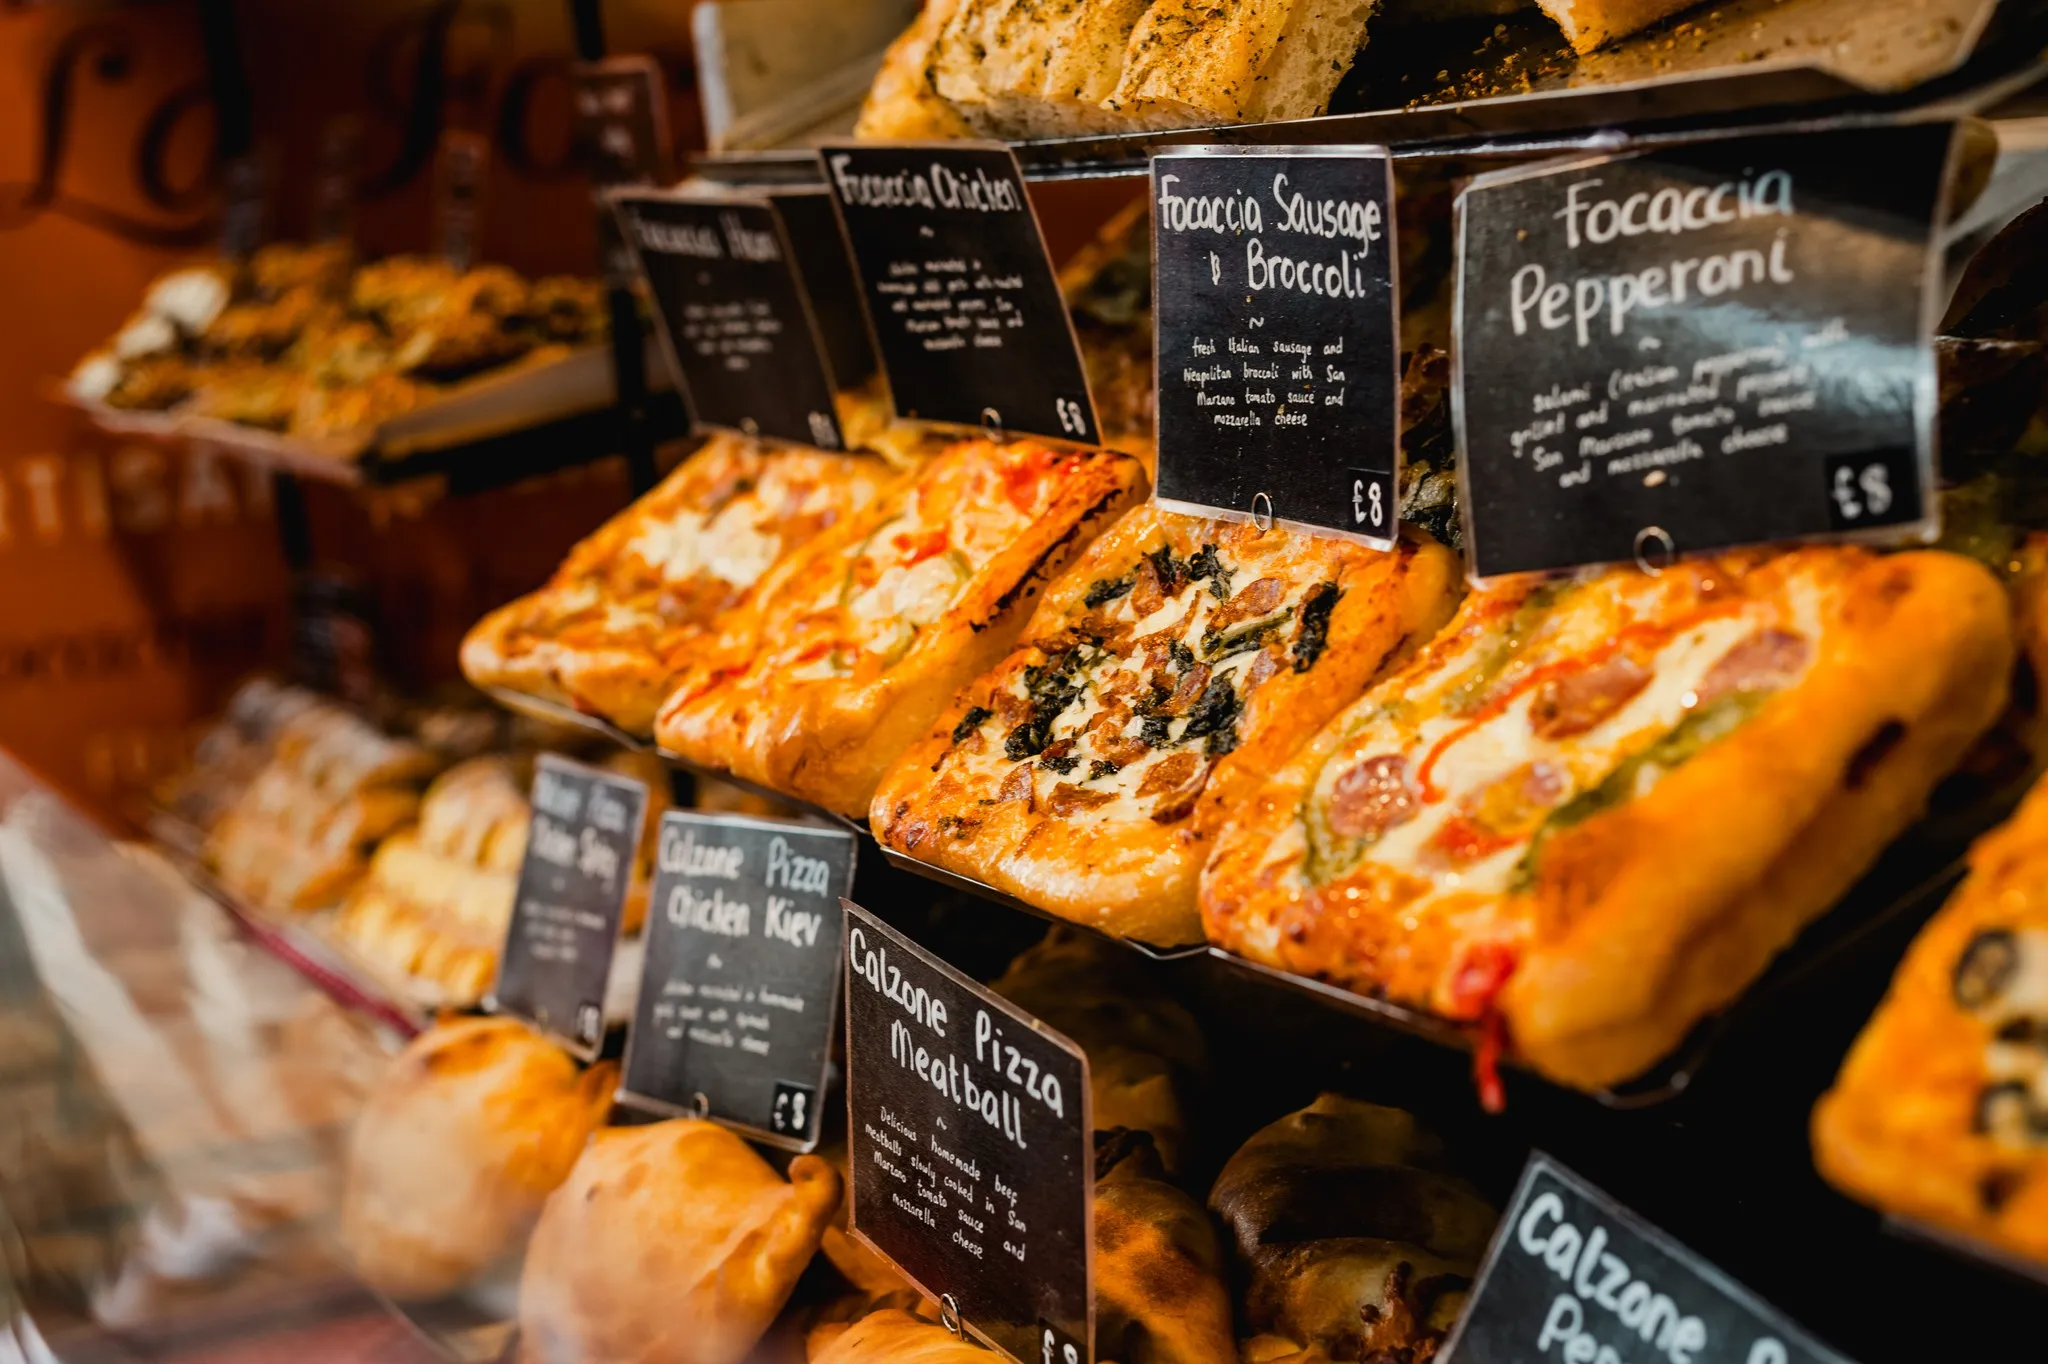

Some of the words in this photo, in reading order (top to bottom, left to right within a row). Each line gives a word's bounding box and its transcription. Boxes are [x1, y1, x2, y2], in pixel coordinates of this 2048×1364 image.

[830, 154, 935, 209] Focaccia
[930, 162, 1022, 212] Chicken
[1553, 167, 1794, 249] Focaccia
[1159, 174, 1262, 234] Focaccia
[1273, 173, 1381, 258] Sausage
[1247, 238, 1365, 298] Broccoli
[1510, 228, 1795, 347] Pepperoni
[1184, 364, 1231, 388] Neapolitan
[1244, 362, 1279, 380] broccoli
[1292, 366, 1312, 380] with
[1327, 364, 1345, 382] San
[1273, 340, 1312, 363] sausage
[1324, 336, 1343, 355] and
[1197, 391, 1235, 406] Marzano
[1245, 388, 1276, 404] tomato
[1288, 391, 1314, 404] sauce
[1325, 388, 1344, 406] and
[1214, 410, 1261, 427] mozzarella
[1275, 412, 1308, 427] cheese
[1352, 479, 1383, 527] £8
[1559, 461, 1591, 488] and
[1832, 462, 1892, 519] £8
[765, 836, 829, 897] Pizza
[667, 885, 750, 936] Chicken
[764, 895, 824, 948] Kiev
[850, 928, 948, 1037] Calzone
[975, 1009, 1064, 1119] Pizza
[891, 1019, 1027, 1149] Meatball
[865, 1123, 902, 1157] meatballs
[911, 1155, 936, 1188] slowly
[944, 1176, 973, 1204] cooked
[985, 1197, 995, 1214] in
[1008, 1210, 1027, 1233] San
[880, 1106, 917, 1141] Delicious
[931, 1135, 981, 1181] homemade
[995, 1174, 1018, 1207] beef
[874, 1150, 907, 1184] Marzano
[917, 1182, 947, 1208] tomato
[958, 1209, 984, 1234] sauce
[1003, 1240, 1026, 1262] and
[892, 1193, 936, 1229] mozzarella
[952, 1231, 983, 1260] cheese
[1518, 1192, 1707, 1364] Calzone
